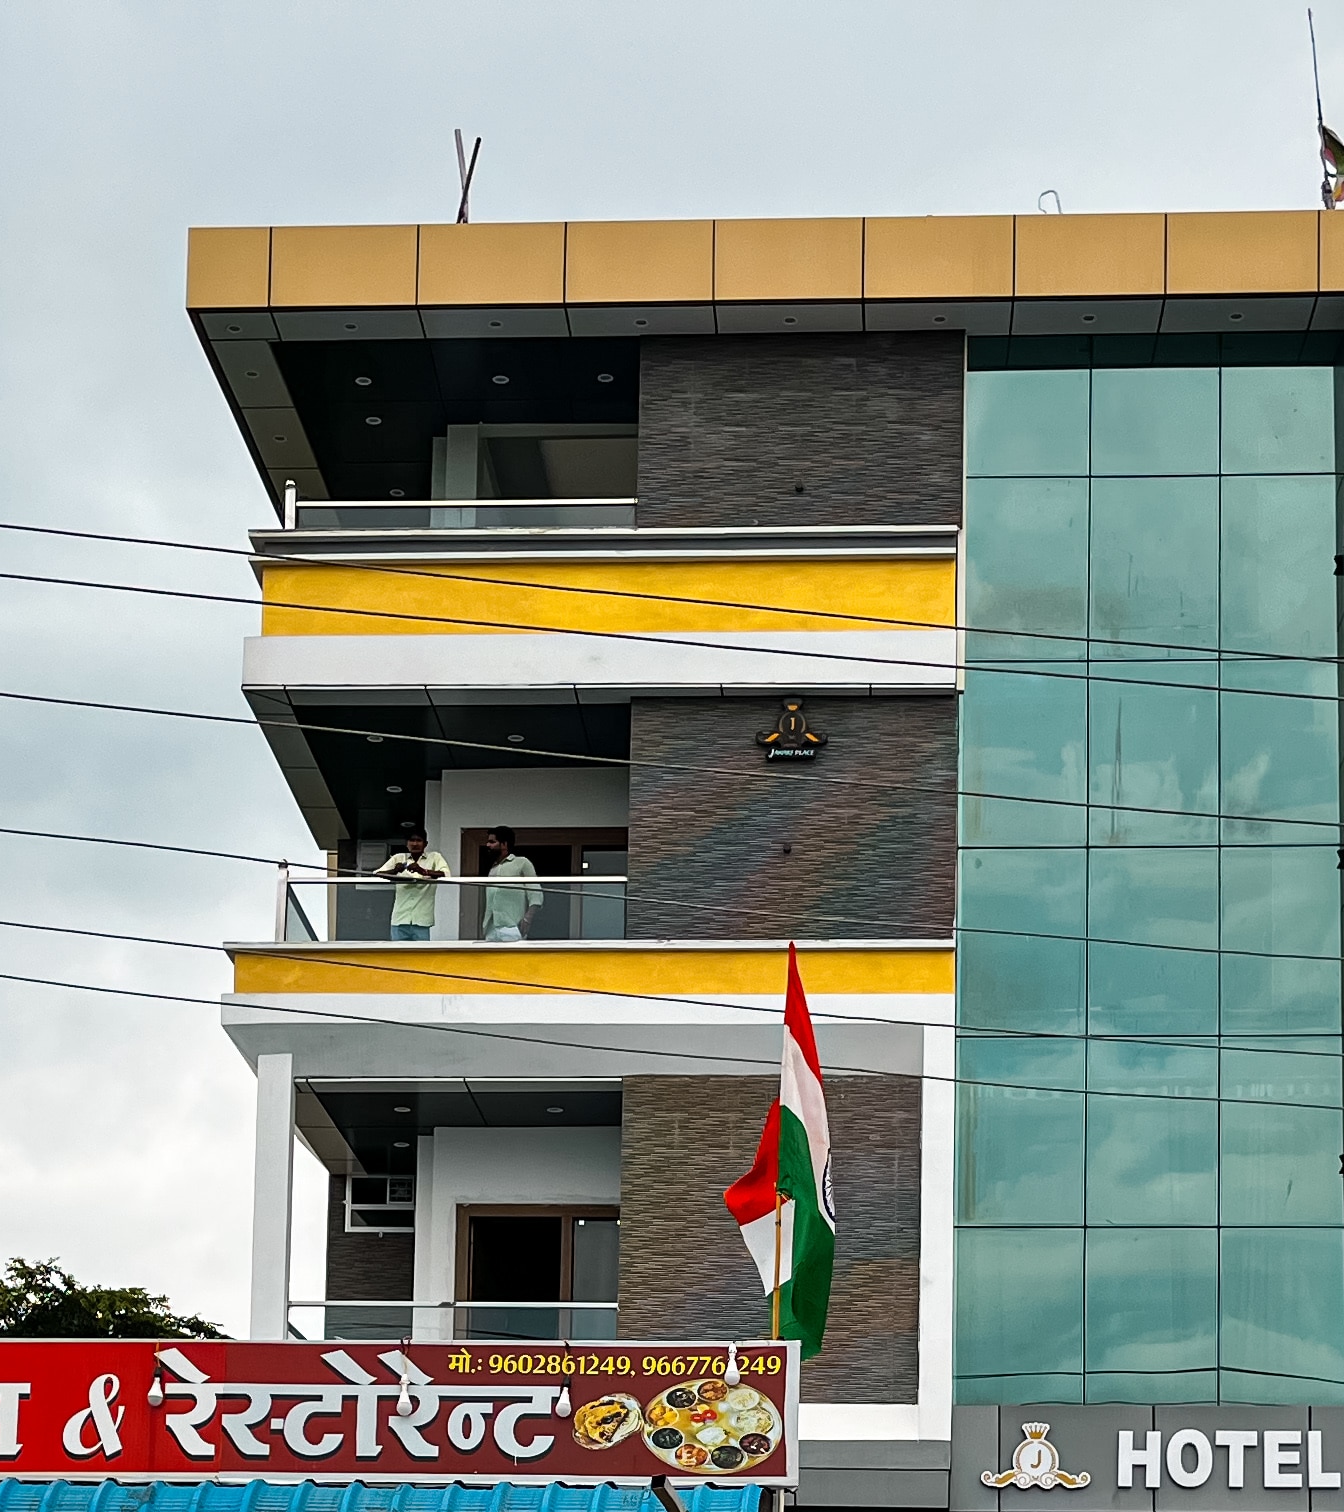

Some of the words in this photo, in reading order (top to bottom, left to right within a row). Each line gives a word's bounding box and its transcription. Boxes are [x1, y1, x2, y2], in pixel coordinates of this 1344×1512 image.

[488, 1353, 636, 1377] 9602861249,
[641, 1354, 782, 1377] 966776249
[62, 1373, 126, 1459] &
[157, 1347, 560, 1461] रेस्टोरेन्ट
[1117, 1428, 1342, 1490] HOTEL
